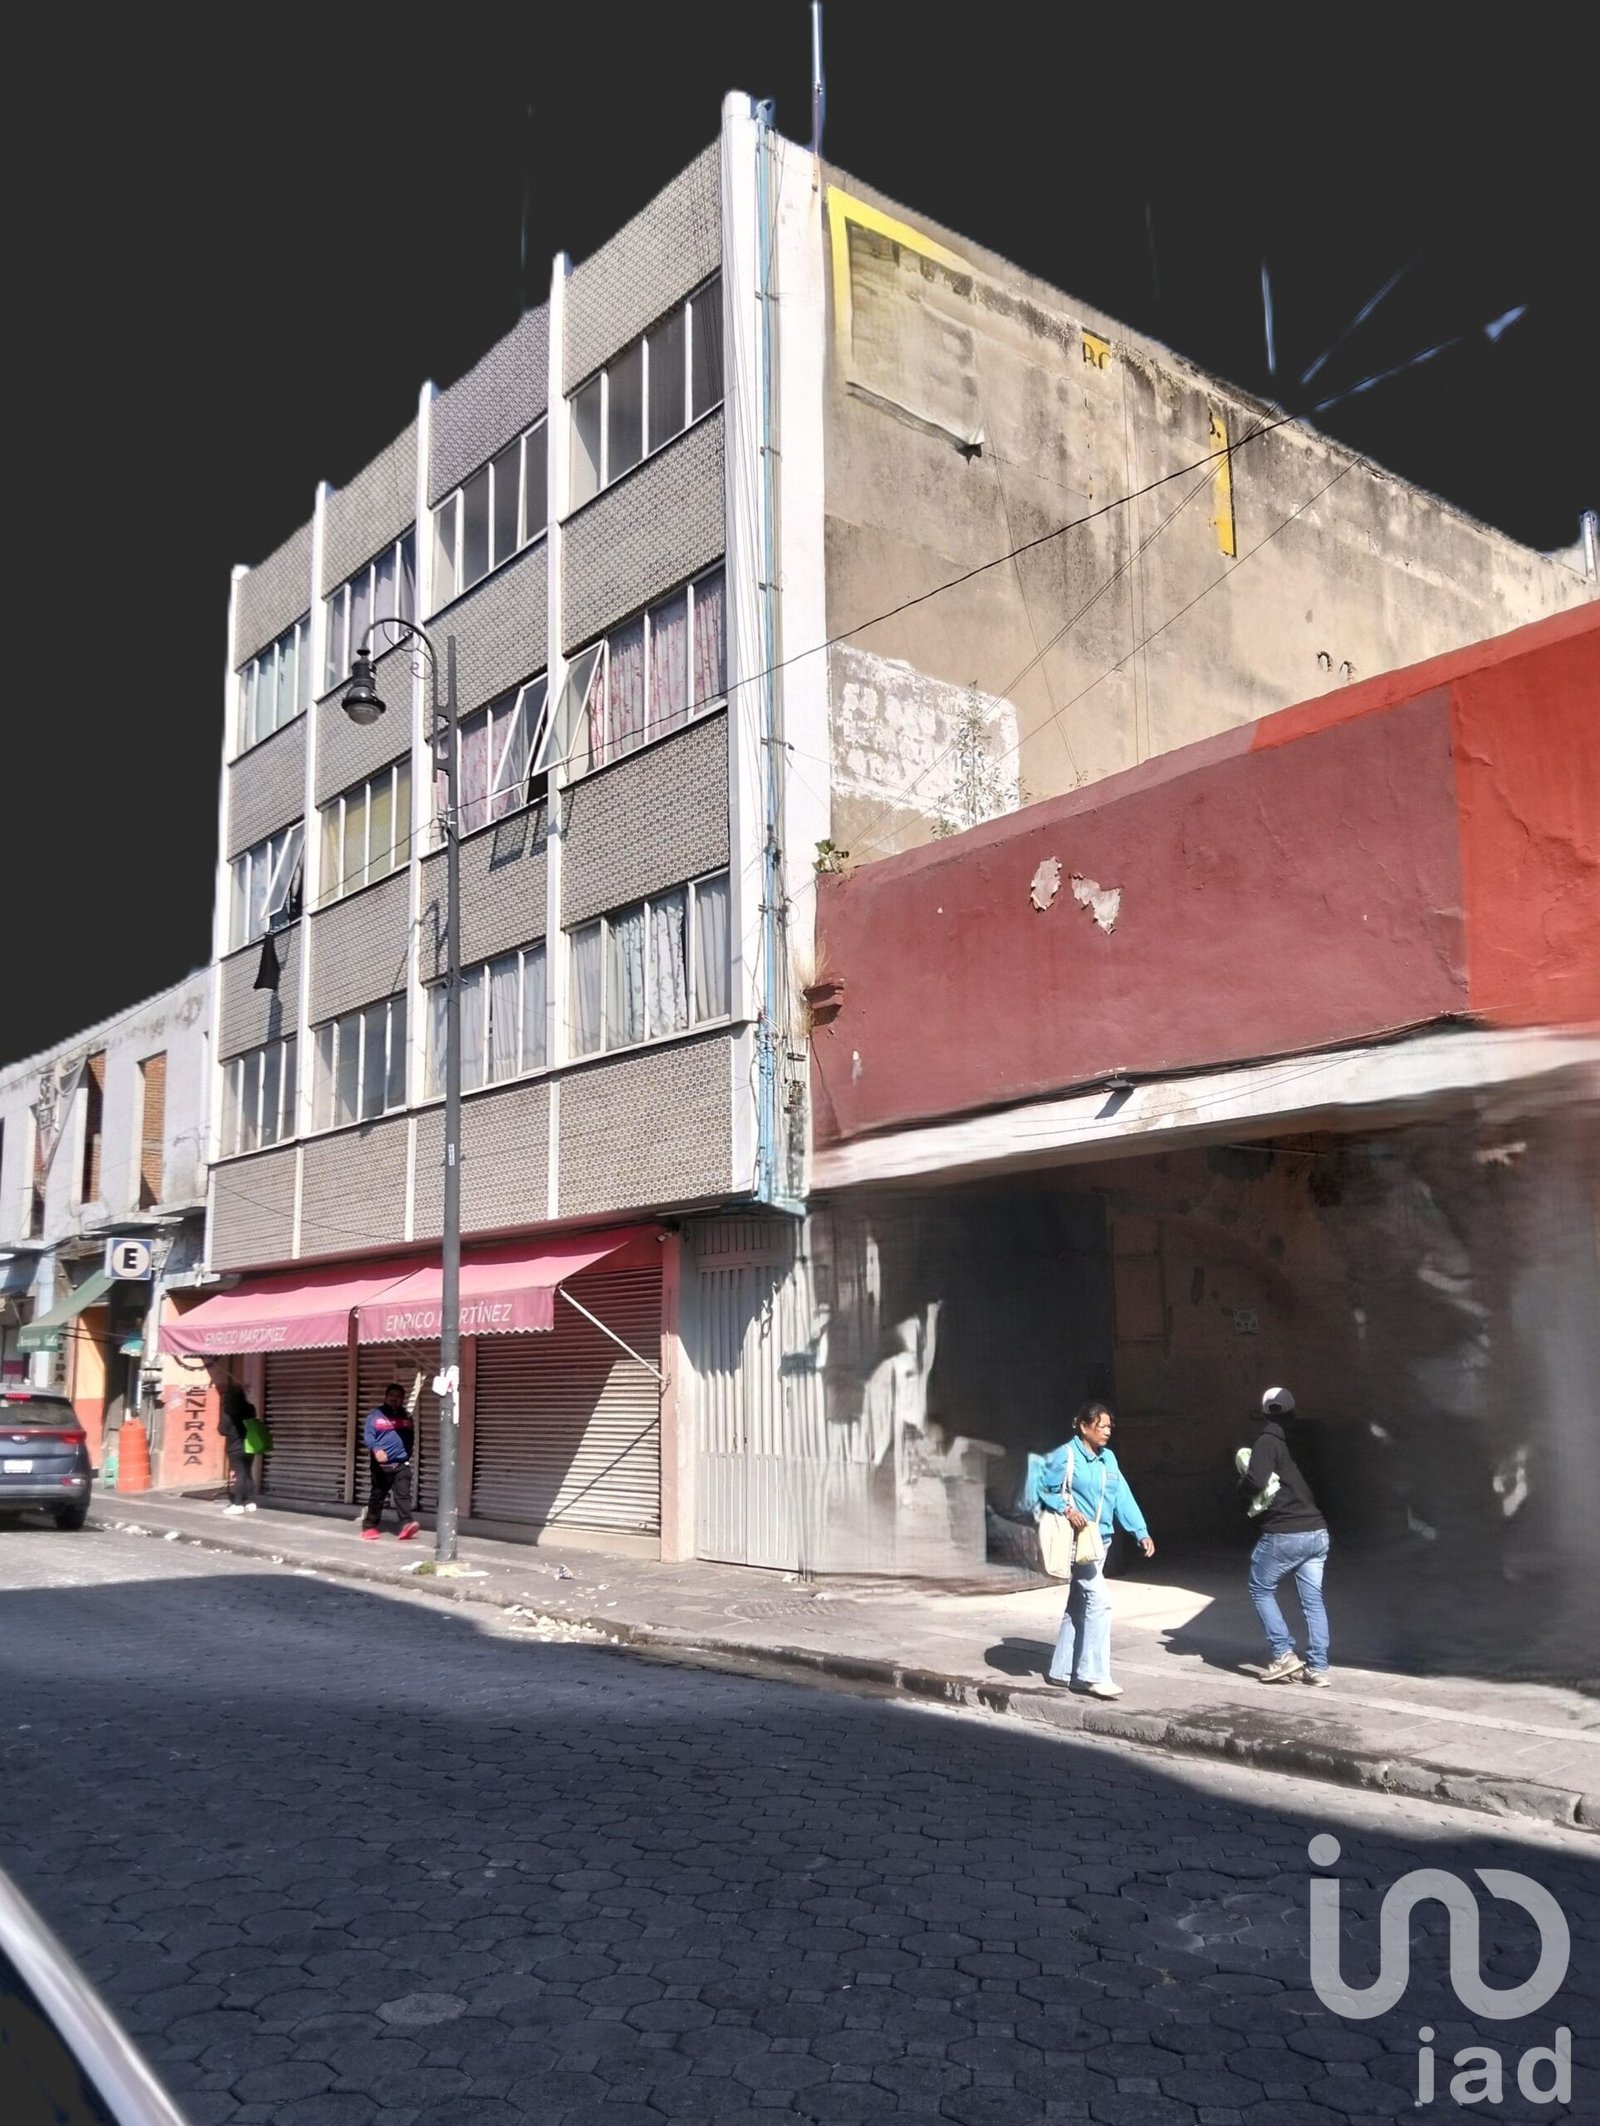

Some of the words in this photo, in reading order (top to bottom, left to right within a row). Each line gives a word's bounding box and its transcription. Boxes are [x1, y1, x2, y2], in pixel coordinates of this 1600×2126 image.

[122, 1247, 138, 1270] E
[386, 1311, 434, 1332] ENRICO
[439, 1301, 513, 1327] RTÍNEZ
[183, 1386, 207, 1466] ENTRADA
